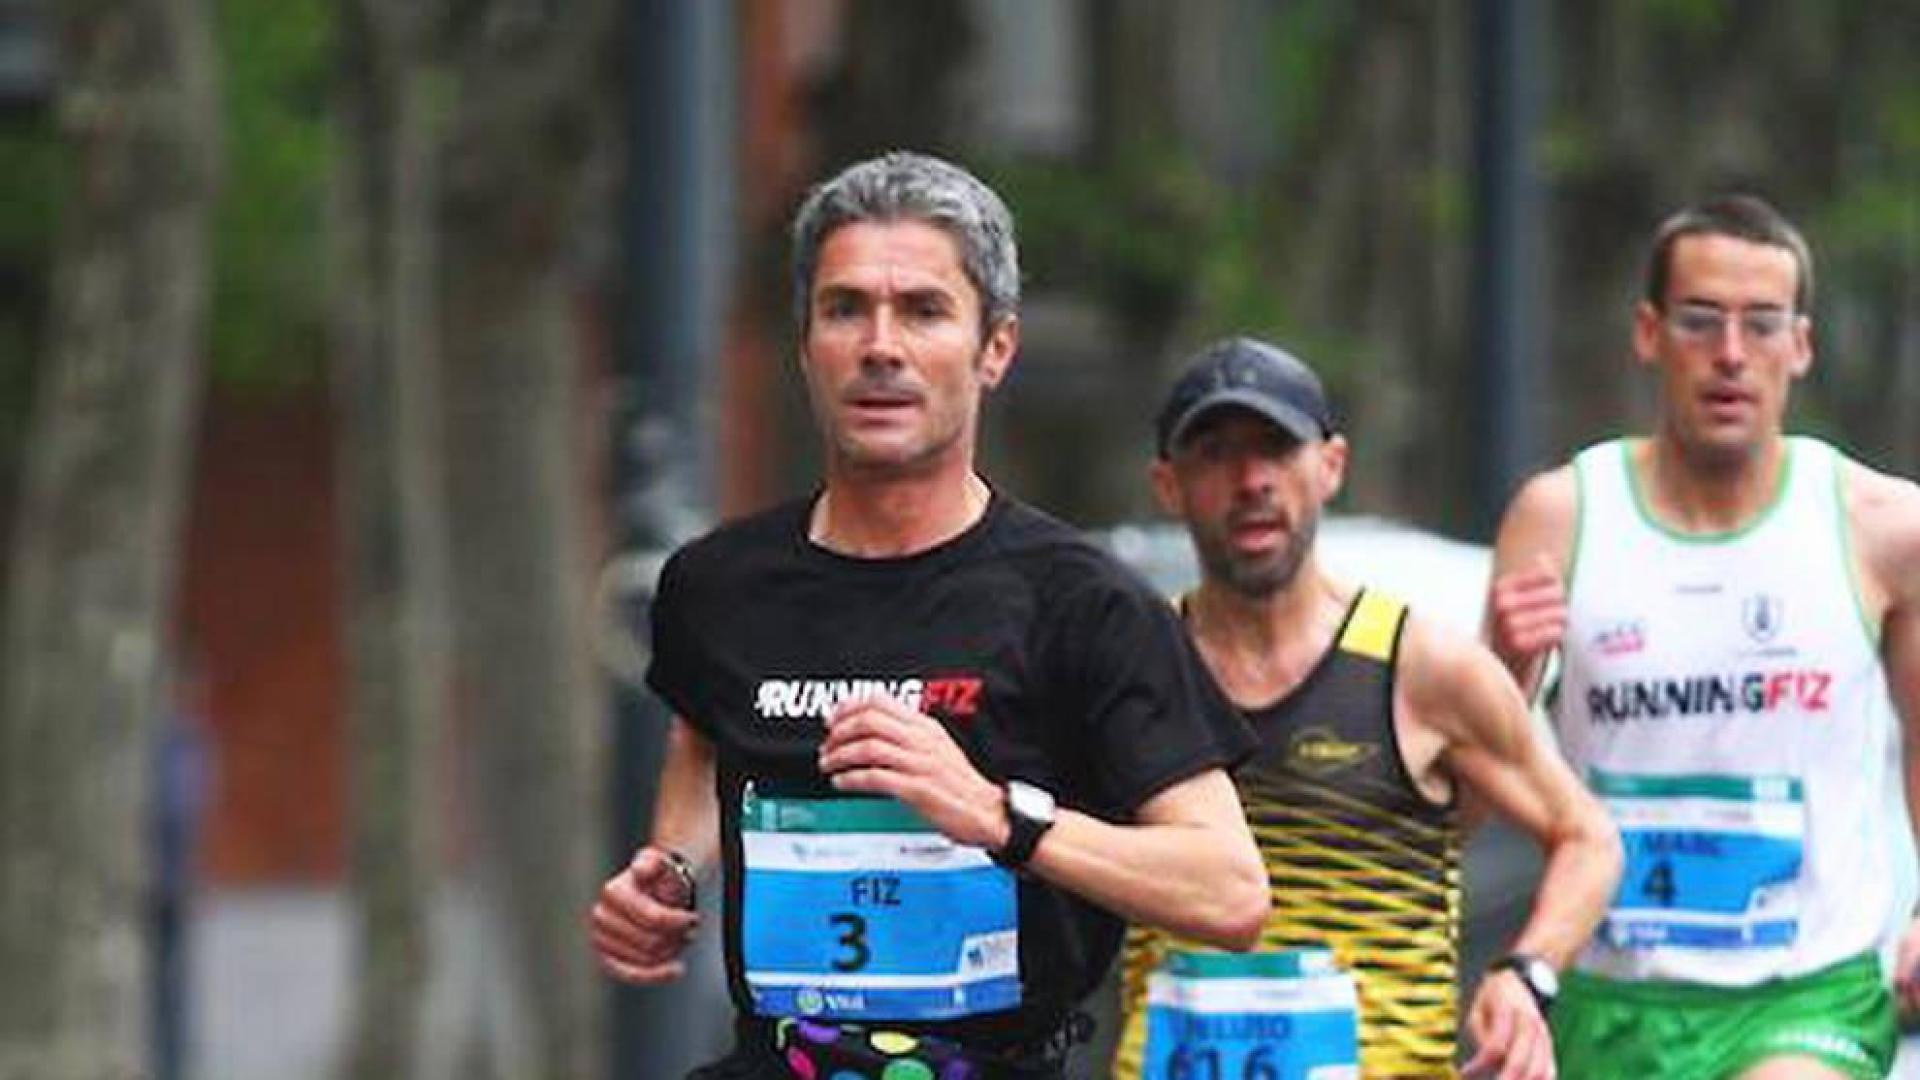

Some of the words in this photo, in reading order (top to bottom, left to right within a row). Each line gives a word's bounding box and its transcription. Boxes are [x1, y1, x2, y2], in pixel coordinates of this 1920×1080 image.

[1586, 672, 1833, 724] RUNNINGFIZ
[851, 877, 901, 906] FIZ
[1642, 860, 1677, 907] 4
[828, 913, 872, 972] 3
